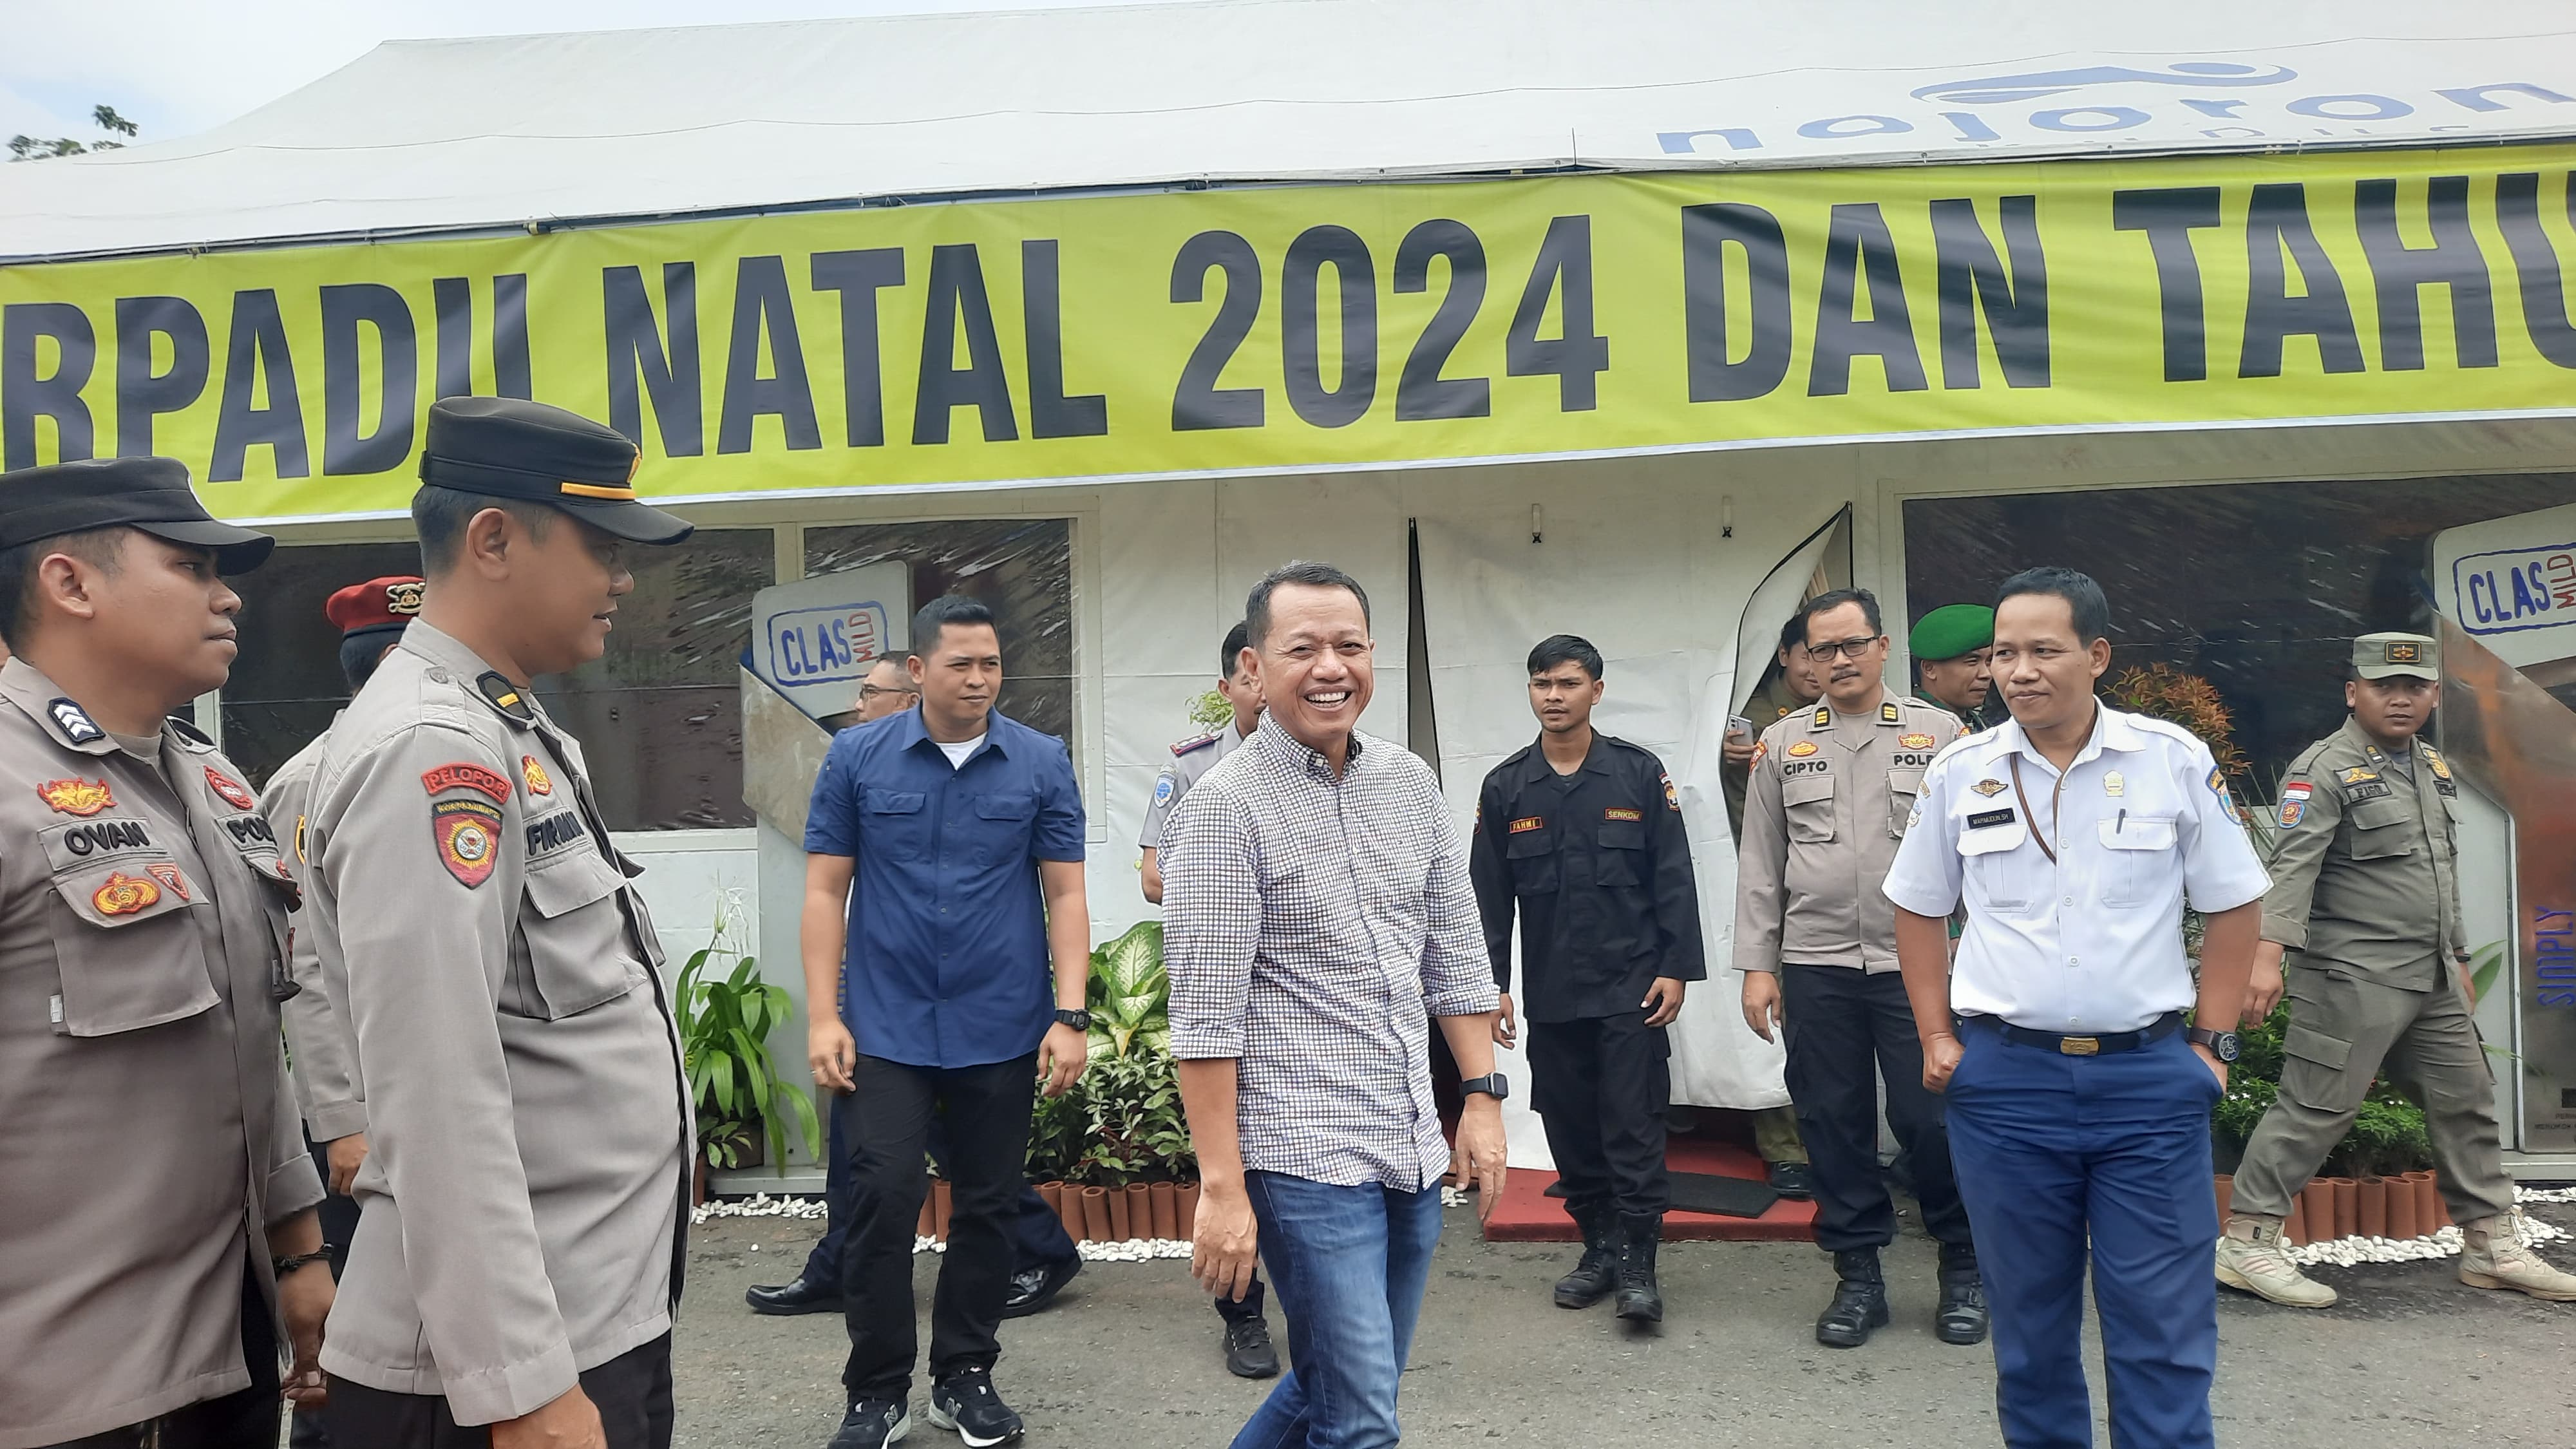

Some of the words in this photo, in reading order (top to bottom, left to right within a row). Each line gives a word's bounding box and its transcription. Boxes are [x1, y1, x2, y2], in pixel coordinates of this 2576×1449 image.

[602, 239, 1108, 457] NATAL
[1170, 214, 1609, 431] 2024
[1681, 195, 2051, 403] DAN
[2113, 171, 2576, 382] TAHU
[2469, 562, 2551, 623] CLAS
[781, 618, 852, 676] CLAS
[848, 612, 878, 663] MILD
[428, 766, 506, 797] PELOPOR
[1783, 761, 1828, 775] CIPTO
[1513, 819, 1536, 831] FAHMI
[1608, 810, 1640, 820] SENKOM
[64, 822, 150, 856] OVAN
[2535, 905, 2576, 1006] SIMPLY
